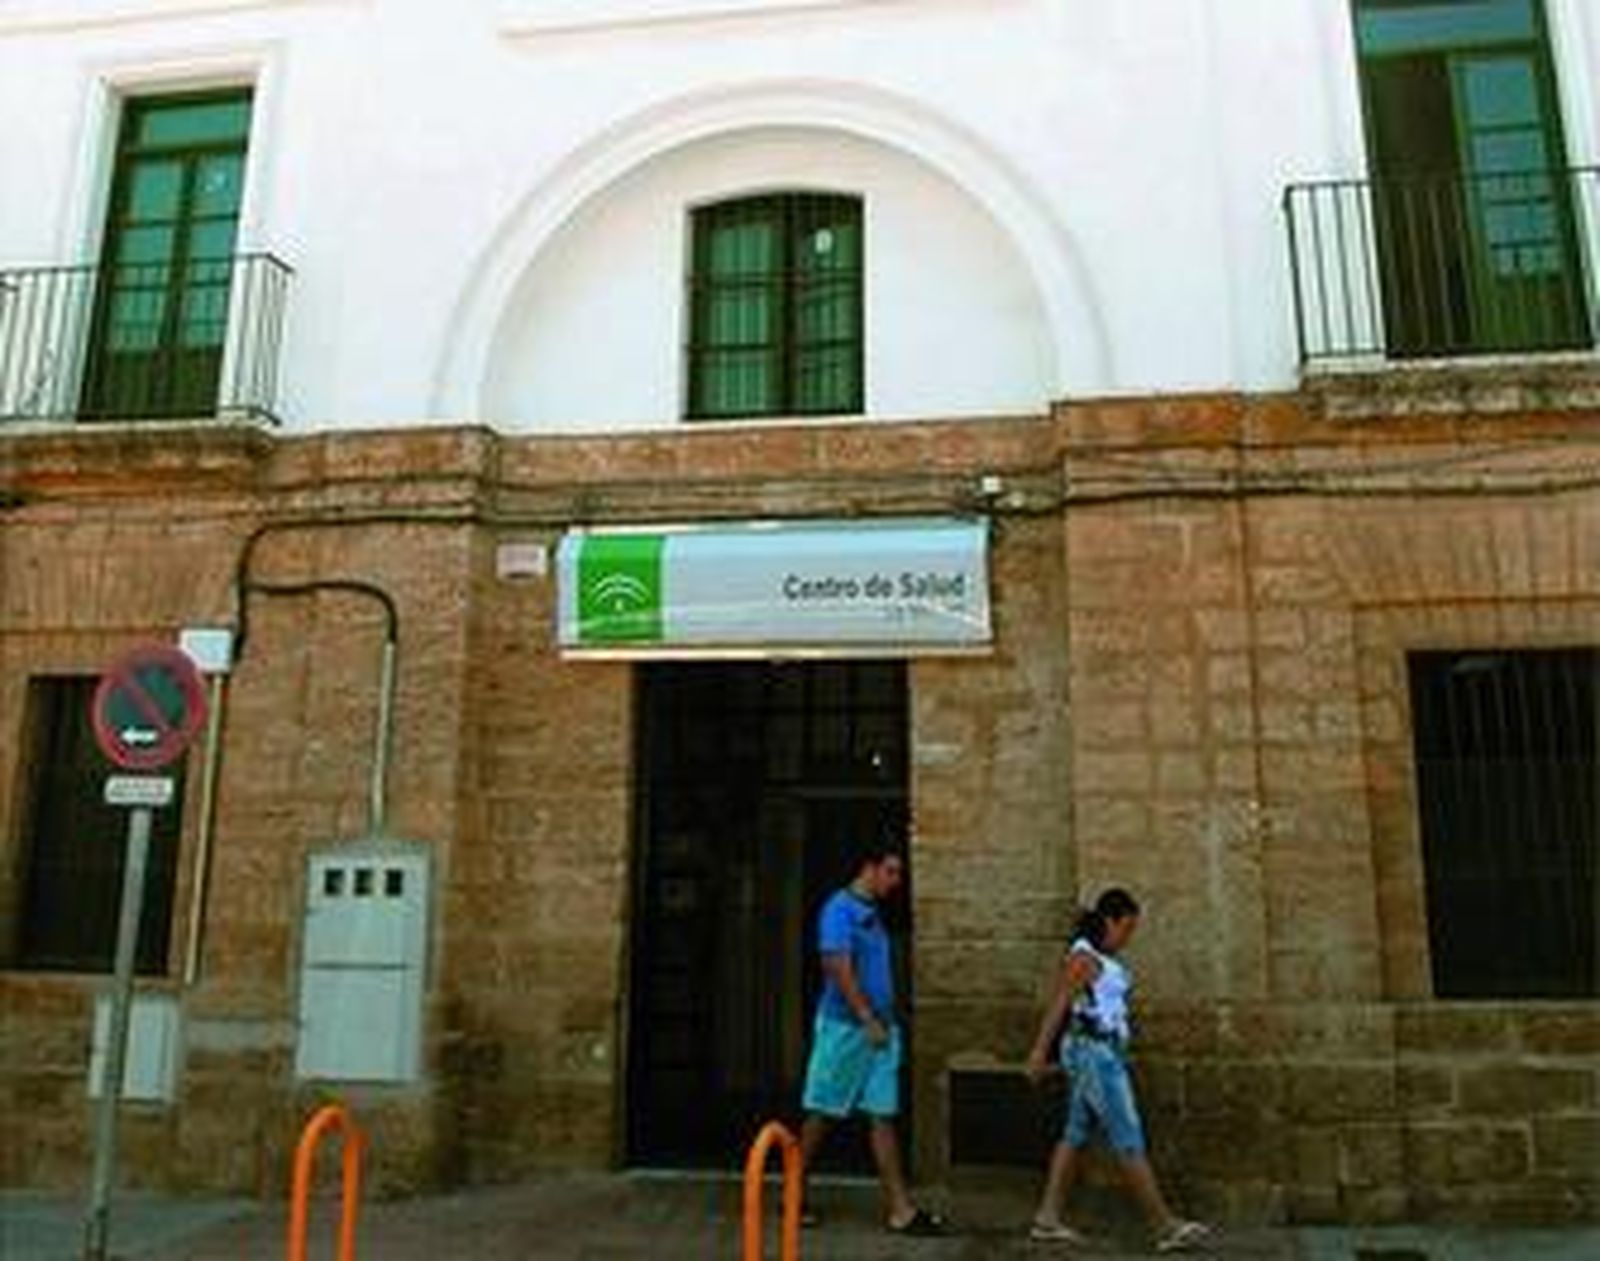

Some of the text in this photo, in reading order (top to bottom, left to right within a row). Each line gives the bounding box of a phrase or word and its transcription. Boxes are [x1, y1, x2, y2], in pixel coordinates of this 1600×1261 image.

[783, 571, 965, 600] Centro de Salud
